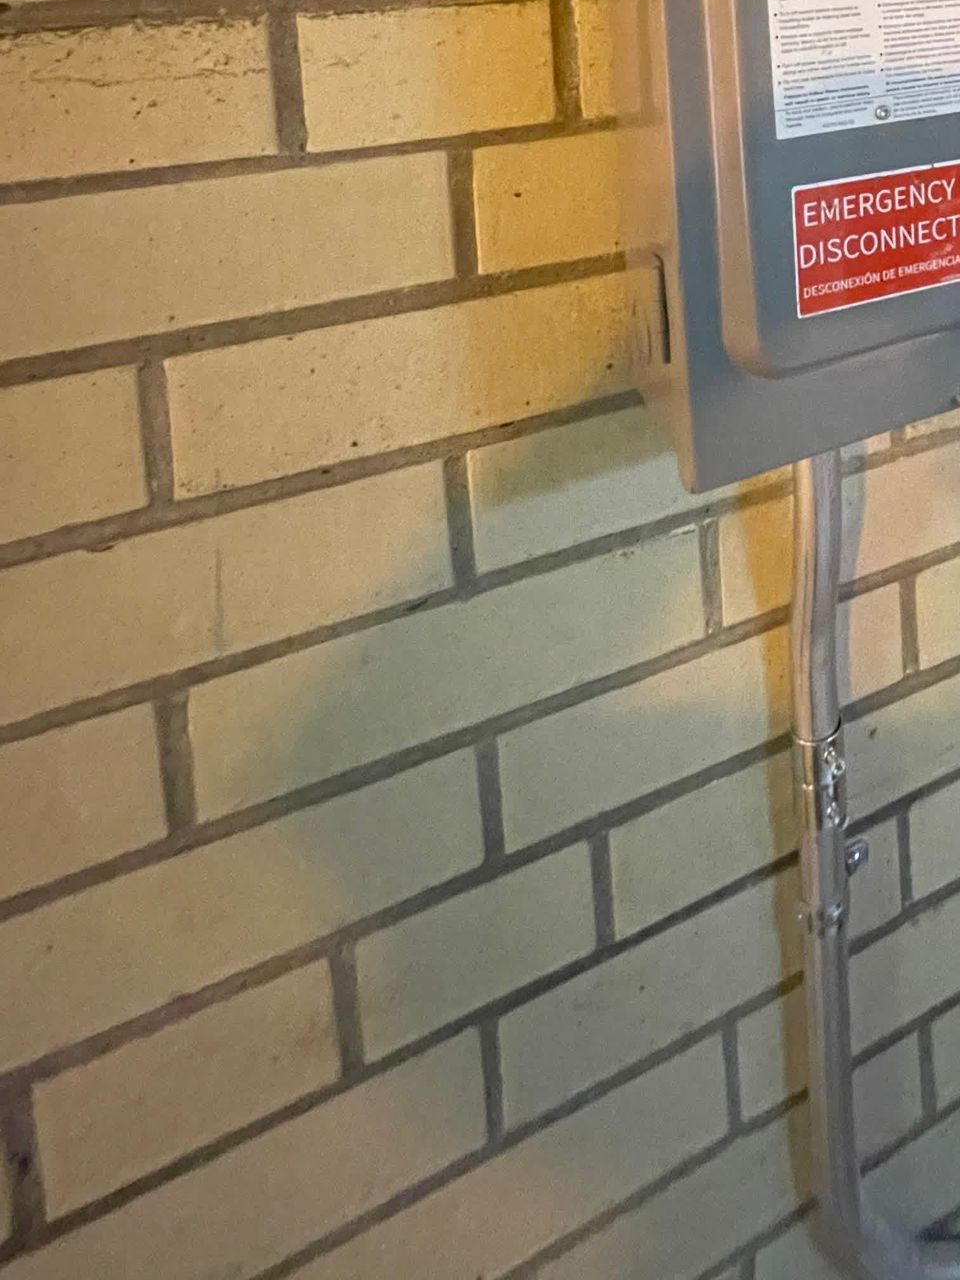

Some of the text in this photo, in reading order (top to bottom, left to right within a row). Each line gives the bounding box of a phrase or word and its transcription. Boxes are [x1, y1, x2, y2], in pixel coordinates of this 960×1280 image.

[803, 178, 956, 227] EMERGENCY
[799, 214, 960, 269] DISCONNECT
[803, 271, 881, 299] DESCONEXIÓN
[882, 268, 897, 280] DE
